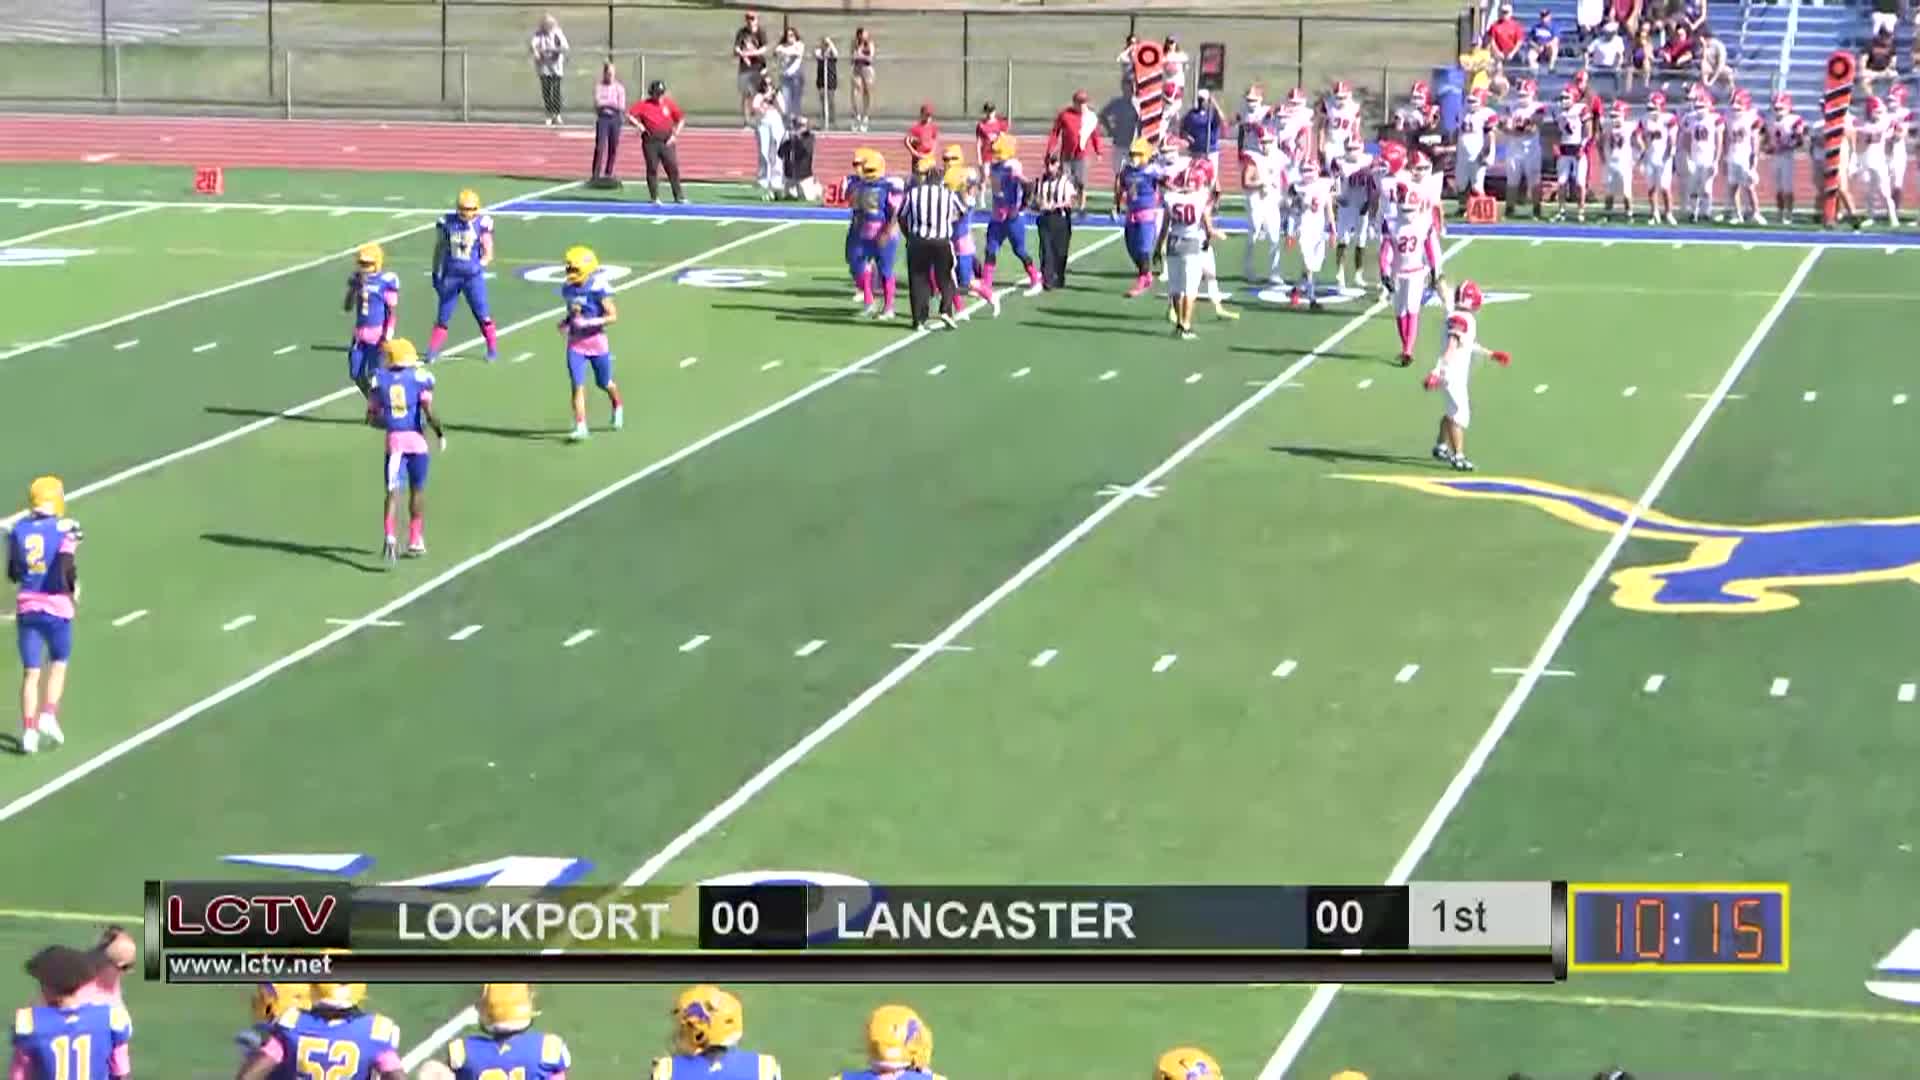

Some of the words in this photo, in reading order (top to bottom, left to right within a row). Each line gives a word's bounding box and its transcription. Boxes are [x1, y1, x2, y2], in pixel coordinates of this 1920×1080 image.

[196, 170, 217, 191] 20
[1172, 204, 1196, 226] 50
[1470, 199, 1494, 219] 40
[1398, 237, 1417, 253] 23
[25, 534, 46, 574] 2
[50, 1034, 93, 1080] 11
[295, 1035, 361, 1080] 52
